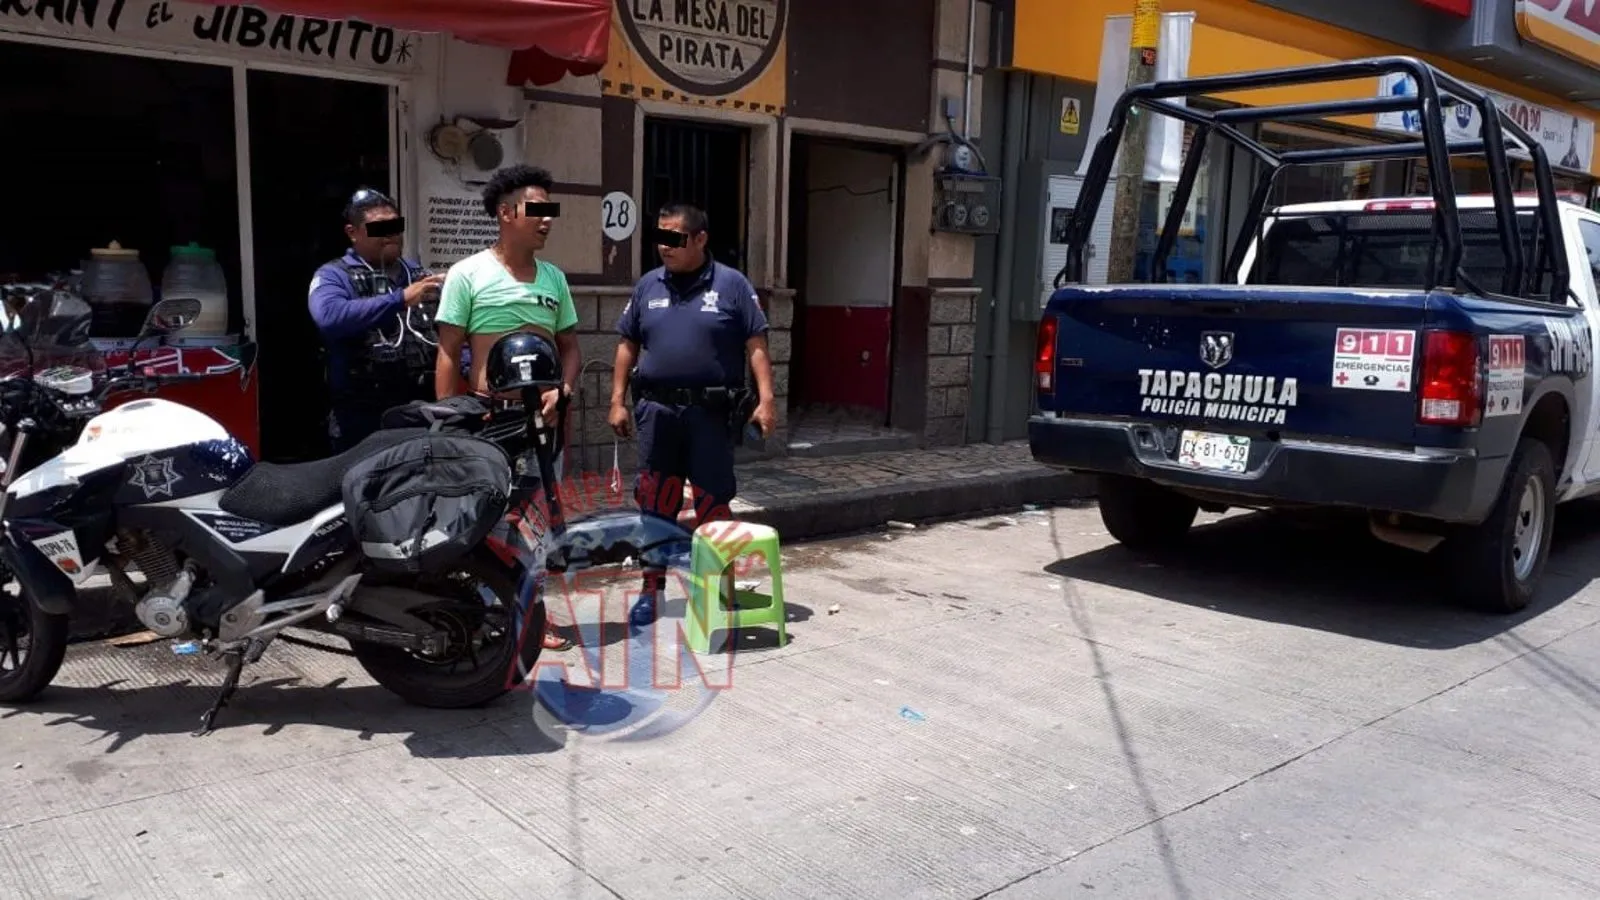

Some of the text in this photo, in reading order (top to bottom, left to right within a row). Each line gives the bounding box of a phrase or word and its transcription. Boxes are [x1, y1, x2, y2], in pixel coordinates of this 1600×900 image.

[146, 2, 174, 29] EL
[193, 5, 394, 64] JIBARITO
[633, 0, 663, 22] LA
[736, 4, 769, 40] DEL
[658, 33, 744, 73] PIRATA
[603, 200, 630, 229] 28
[1335, 361, 1411, 373] EMERGENCIAS
[1138, 368, 1298, 407] TAPACHULA
[1141, 397, 1287, 425] POLICÍA MUNICIPA
